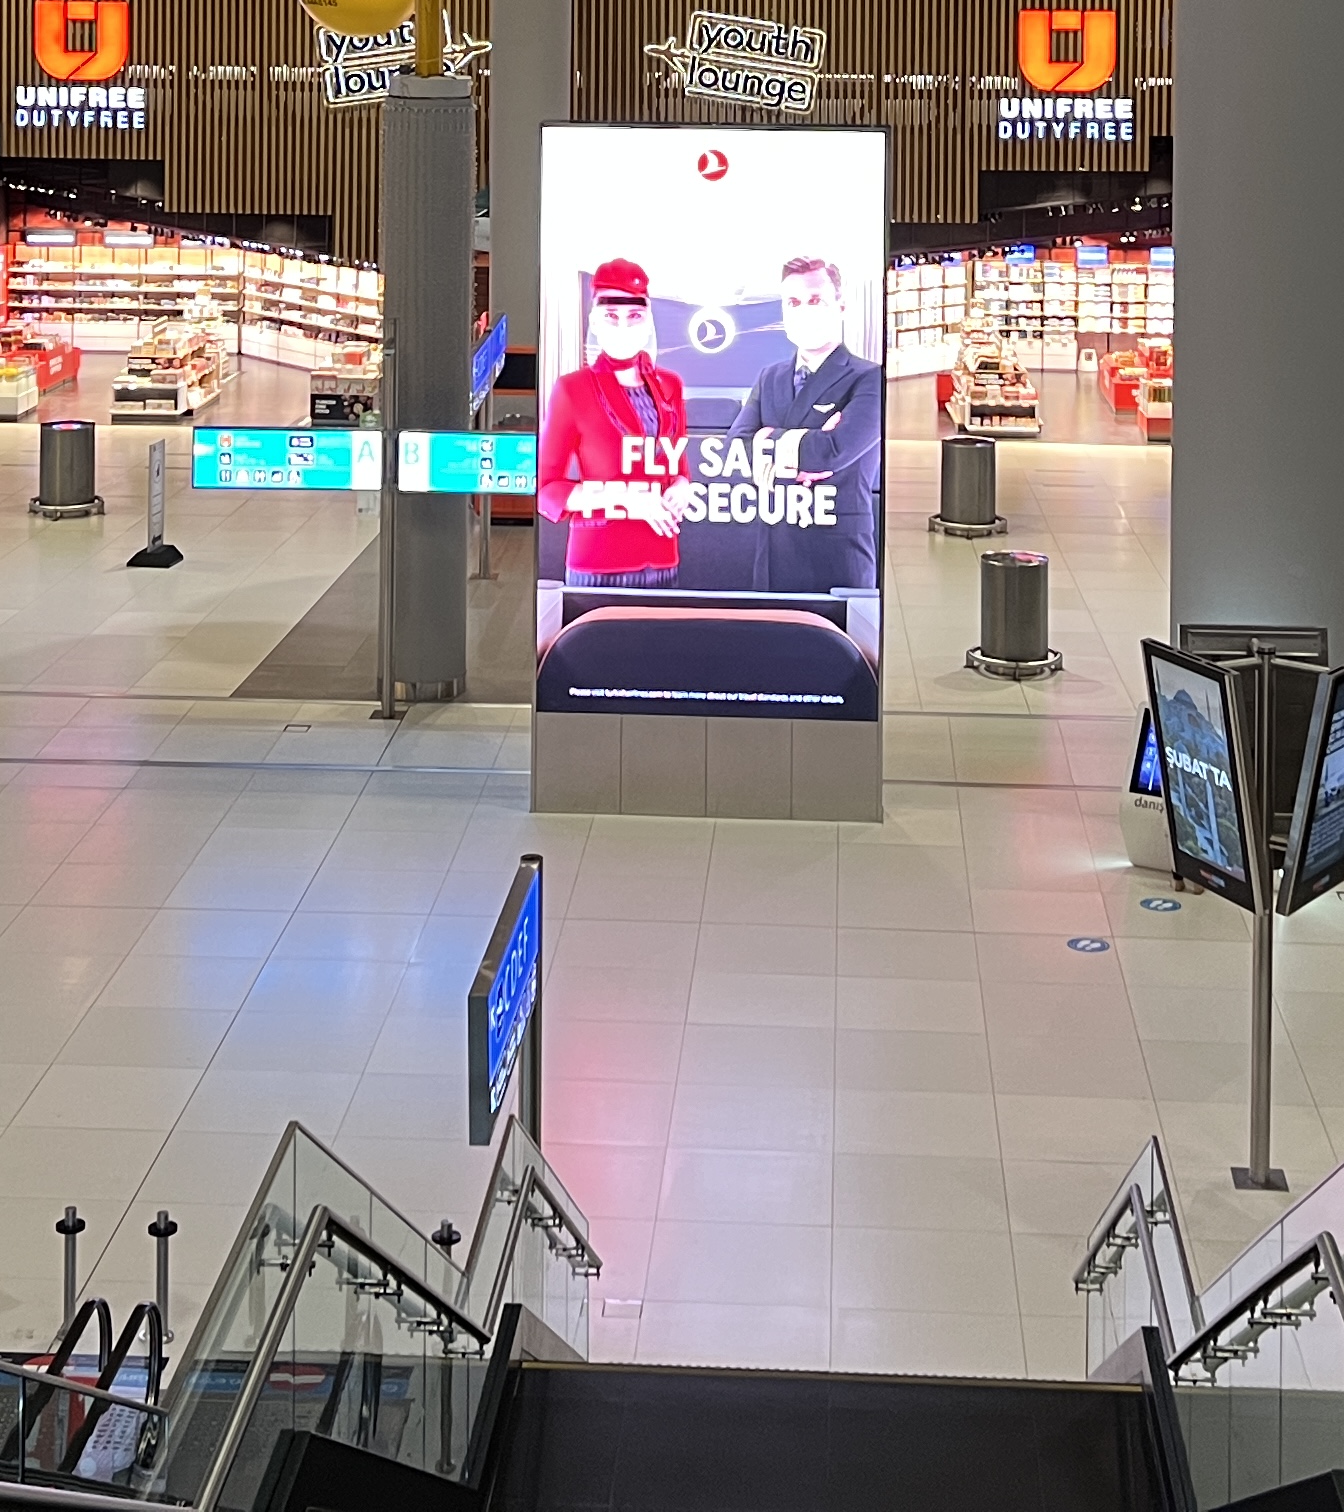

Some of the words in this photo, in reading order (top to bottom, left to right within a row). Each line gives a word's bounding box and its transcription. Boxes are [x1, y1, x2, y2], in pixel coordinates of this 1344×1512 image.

[327, 22, 418, 63] yout
[701, 23, 815, 62] youth
[16, 86, 145, 108] UNIFREE
[688, 54, 806, 107] lounge
[16, 109, 145, 129] DUTYFREE
[999, 97, 1133, 119] UNIFREE
[998, 120, 1133, 140] DUTYFREE
[622, 436, 688, 475] FLY
[698, 437, 799, 479] SAFE
[683, 482, 838, 526] SECURE
